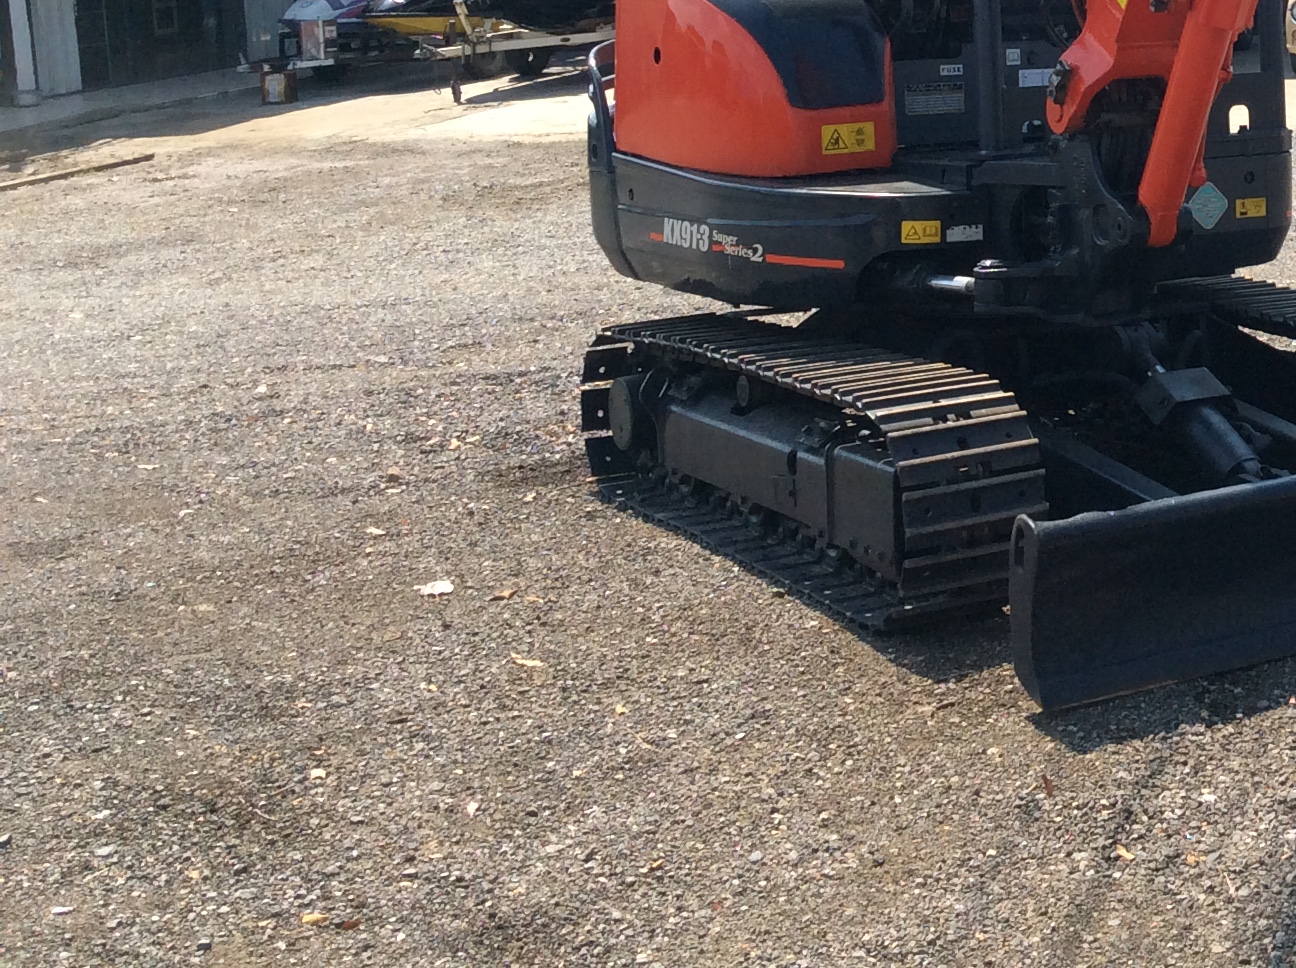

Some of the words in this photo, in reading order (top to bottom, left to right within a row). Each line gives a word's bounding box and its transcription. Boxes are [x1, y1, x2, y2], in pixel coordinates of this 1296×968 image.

[663, 217, 709, 252] KX91-3
[712, 230, 738, 246] Super
[724, 244, 753, 259] Series
